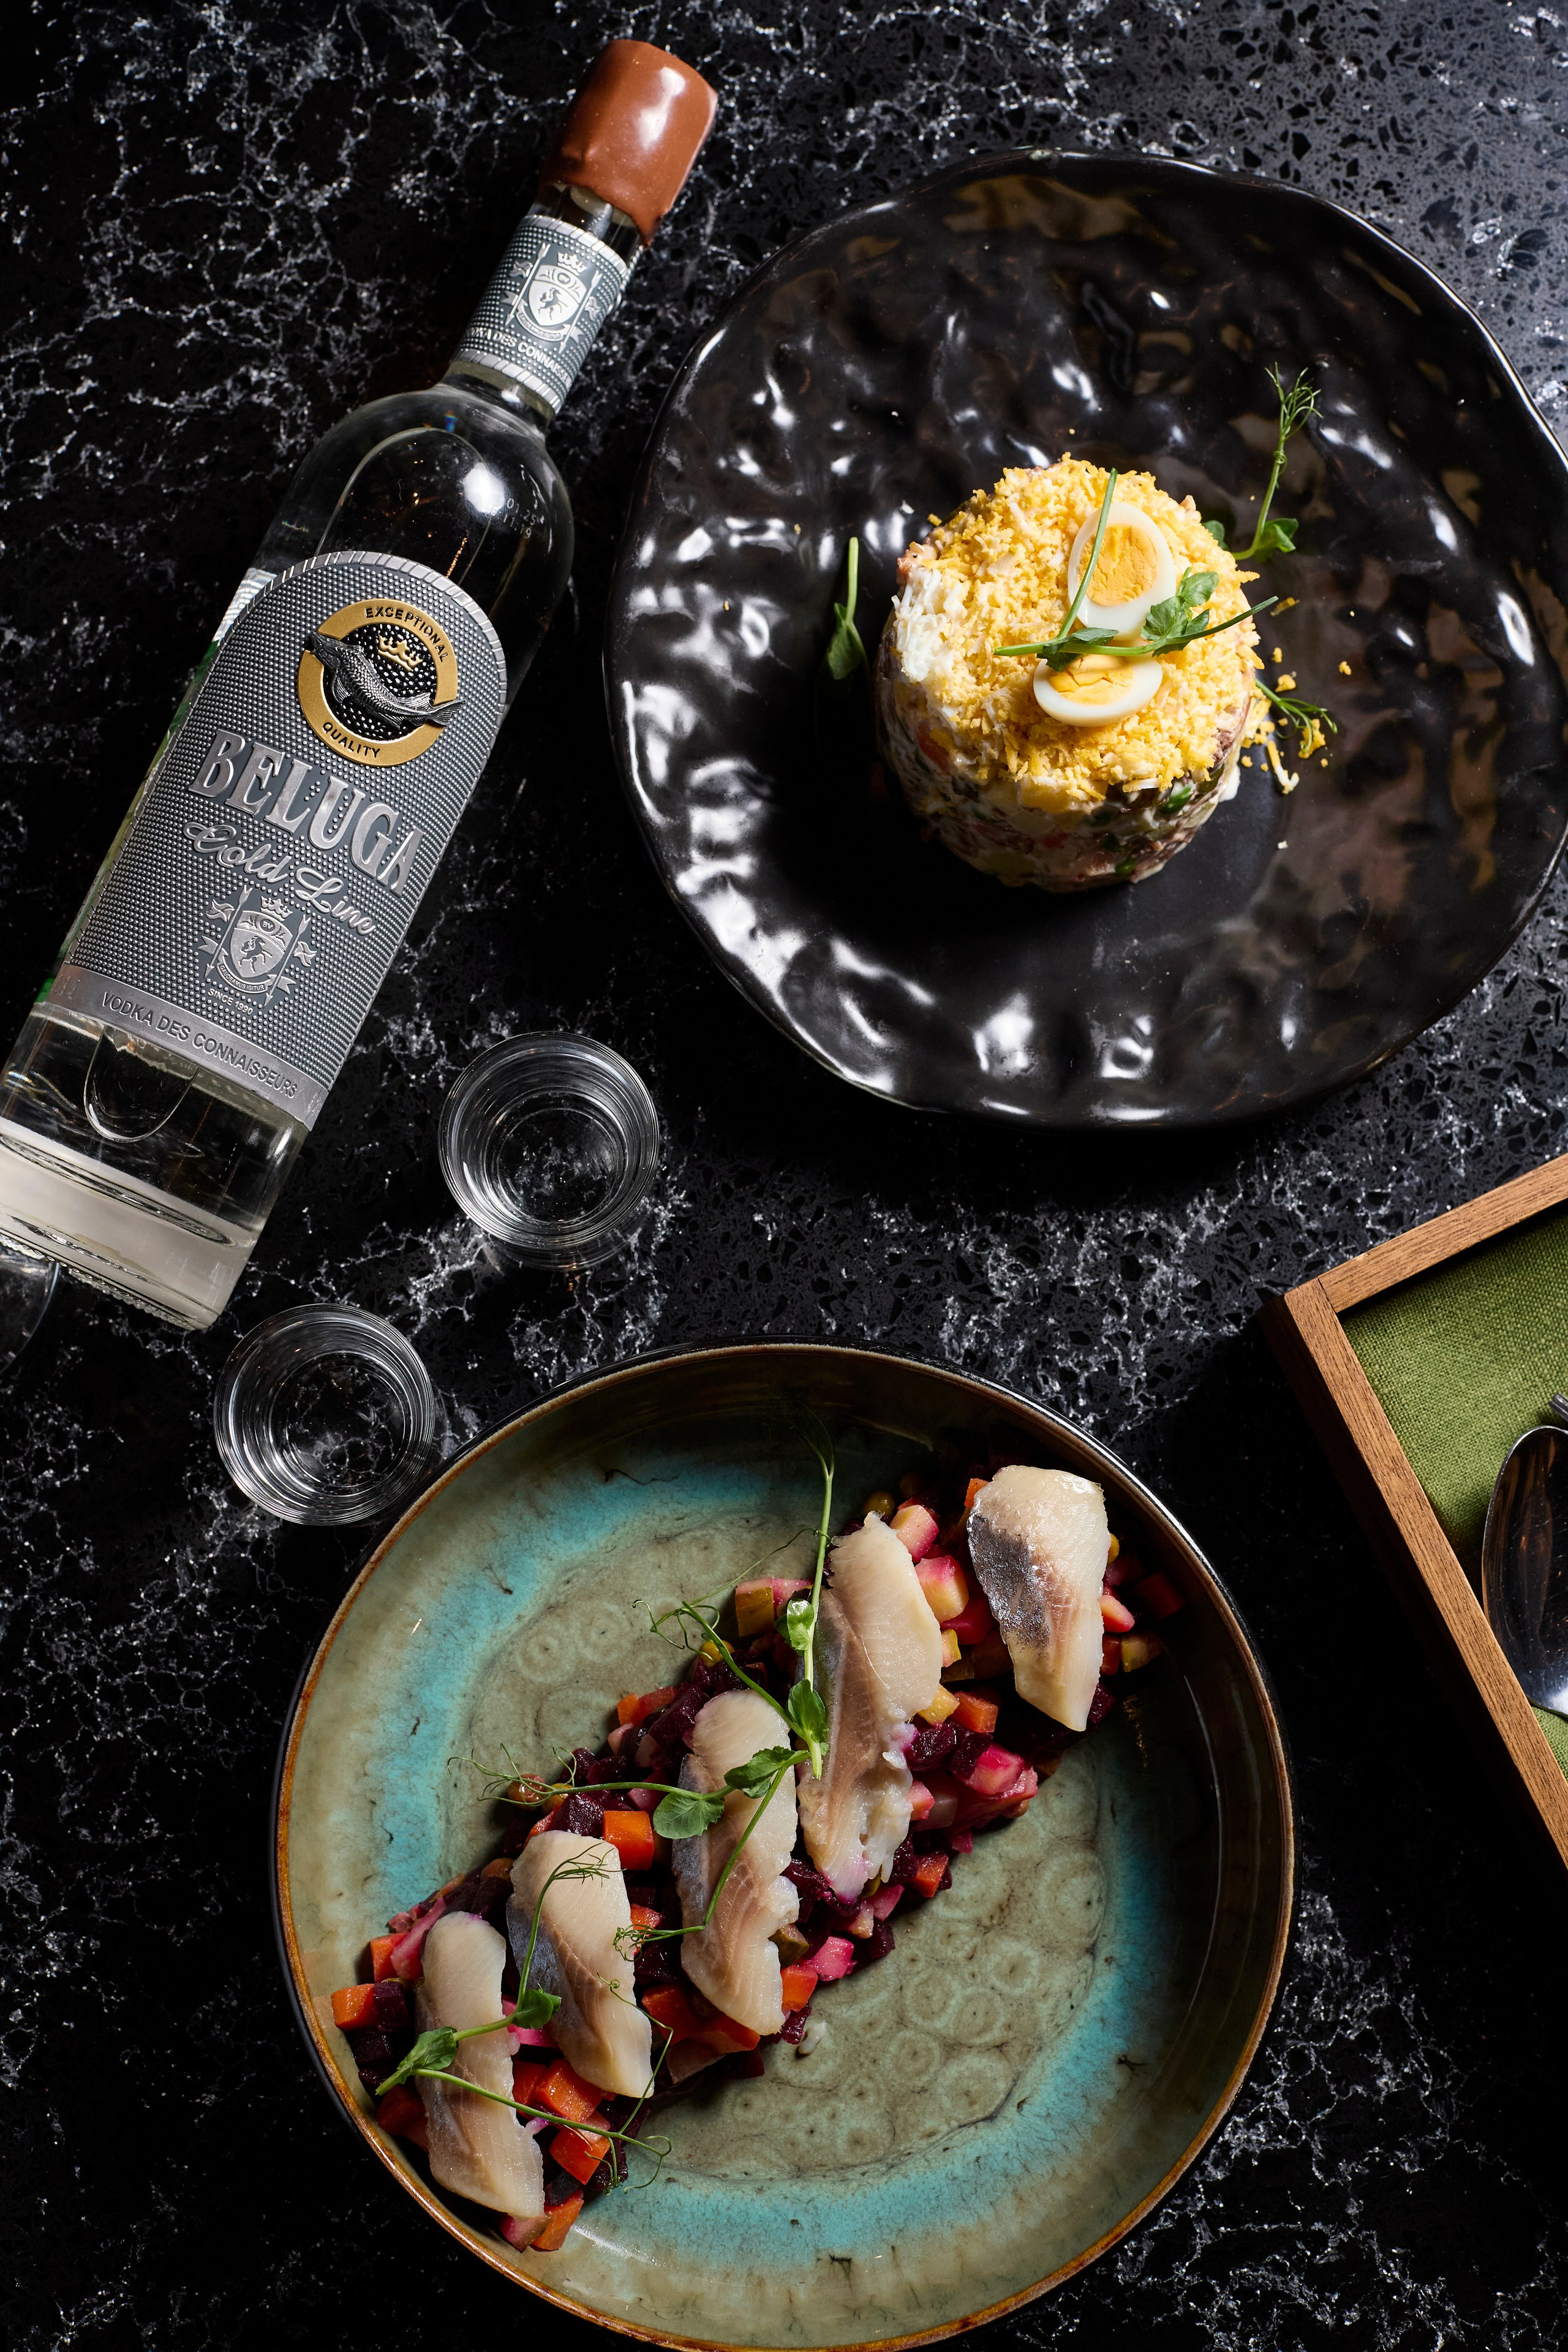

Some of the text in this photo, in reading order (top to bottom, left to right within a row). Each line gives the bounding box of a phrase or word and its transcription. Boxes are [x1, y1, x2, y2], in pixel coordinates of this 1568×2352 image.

[492, 331, 518, 347] DES
[365, 606, 448, 663] EXCEPTIONAL
[322, 722, 381, 758] QUALITY
[188, 729, 425, 898] BELUGA
[183, 821, 376, 936] Gold Line
[262, 920, 273, 930] BV
[219, 965, 246, 989] GAUDEAMUS
[208, 987, 254, 1015] SINCE 1990
[102, 991, 298, 1099] VODKA DES CONNAISSEURS
